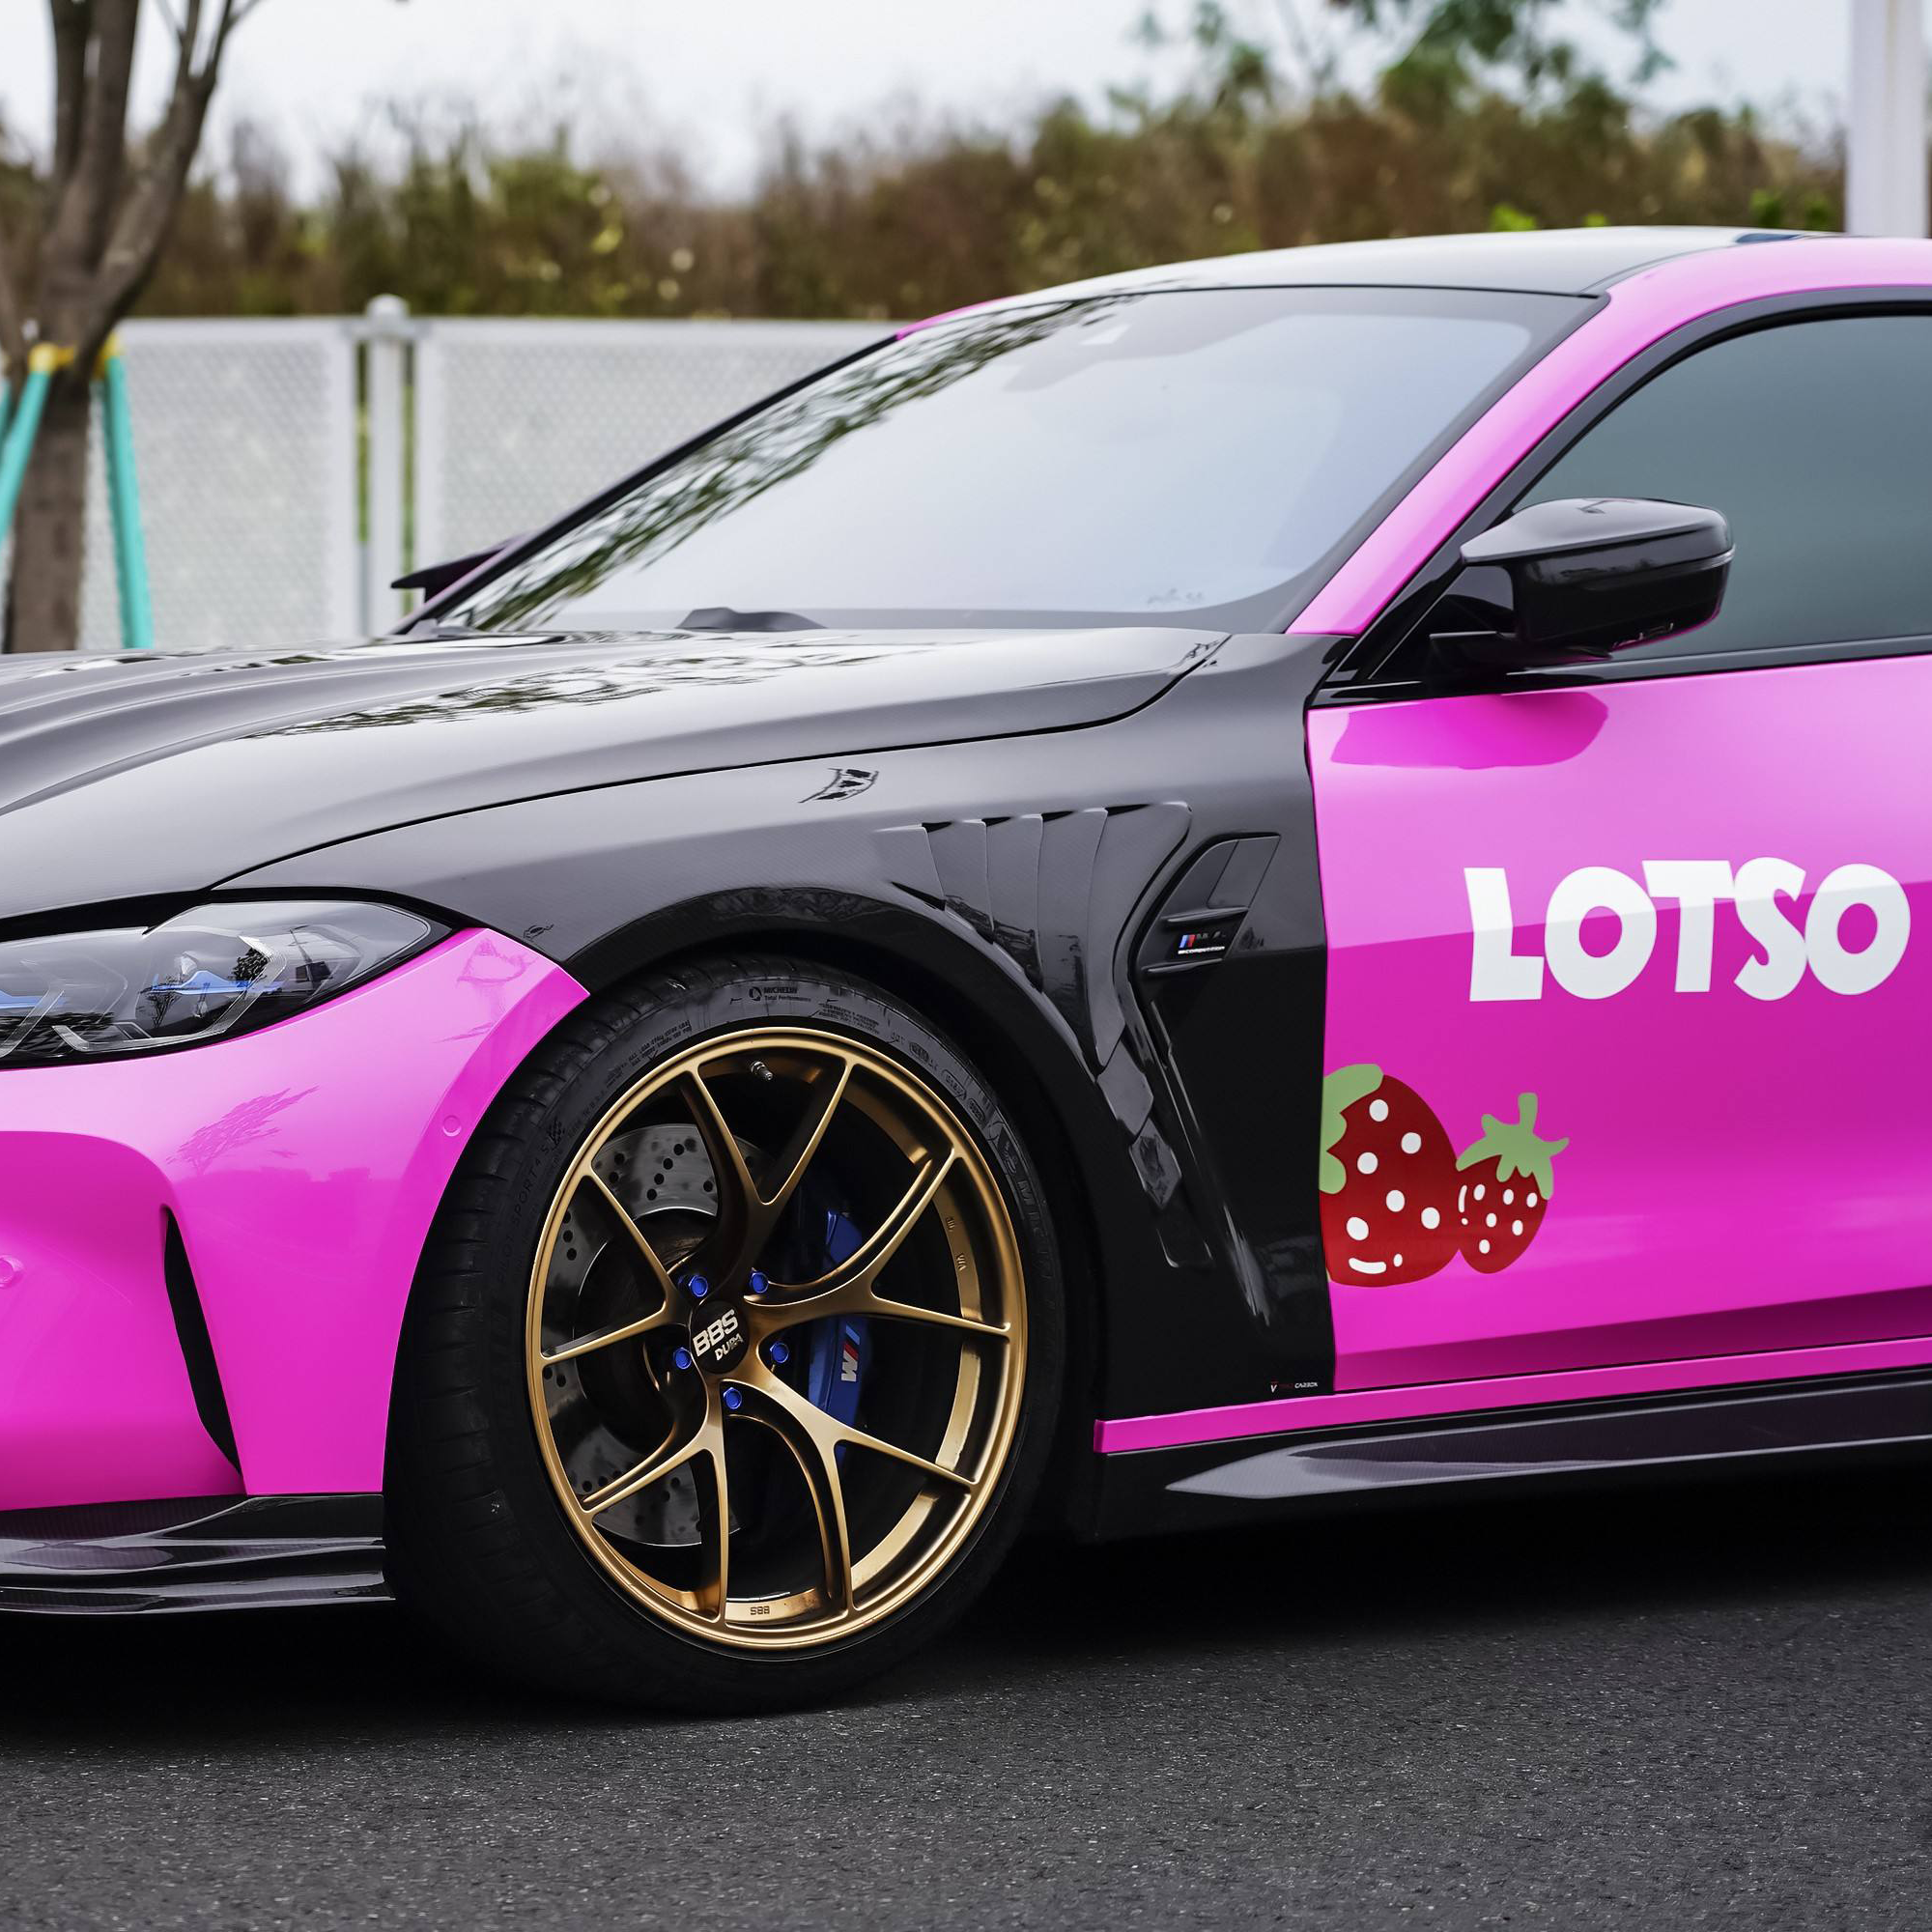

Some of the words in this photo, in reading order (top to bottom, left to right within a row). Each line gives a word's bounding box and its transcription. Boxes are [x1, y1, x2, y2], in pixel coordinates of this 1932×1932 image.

[1463, 856, 1911, 1002] LOTSO
[510, 1167, 537, 1228] SPORT
[692, 1308, 739, 1357] BBS
